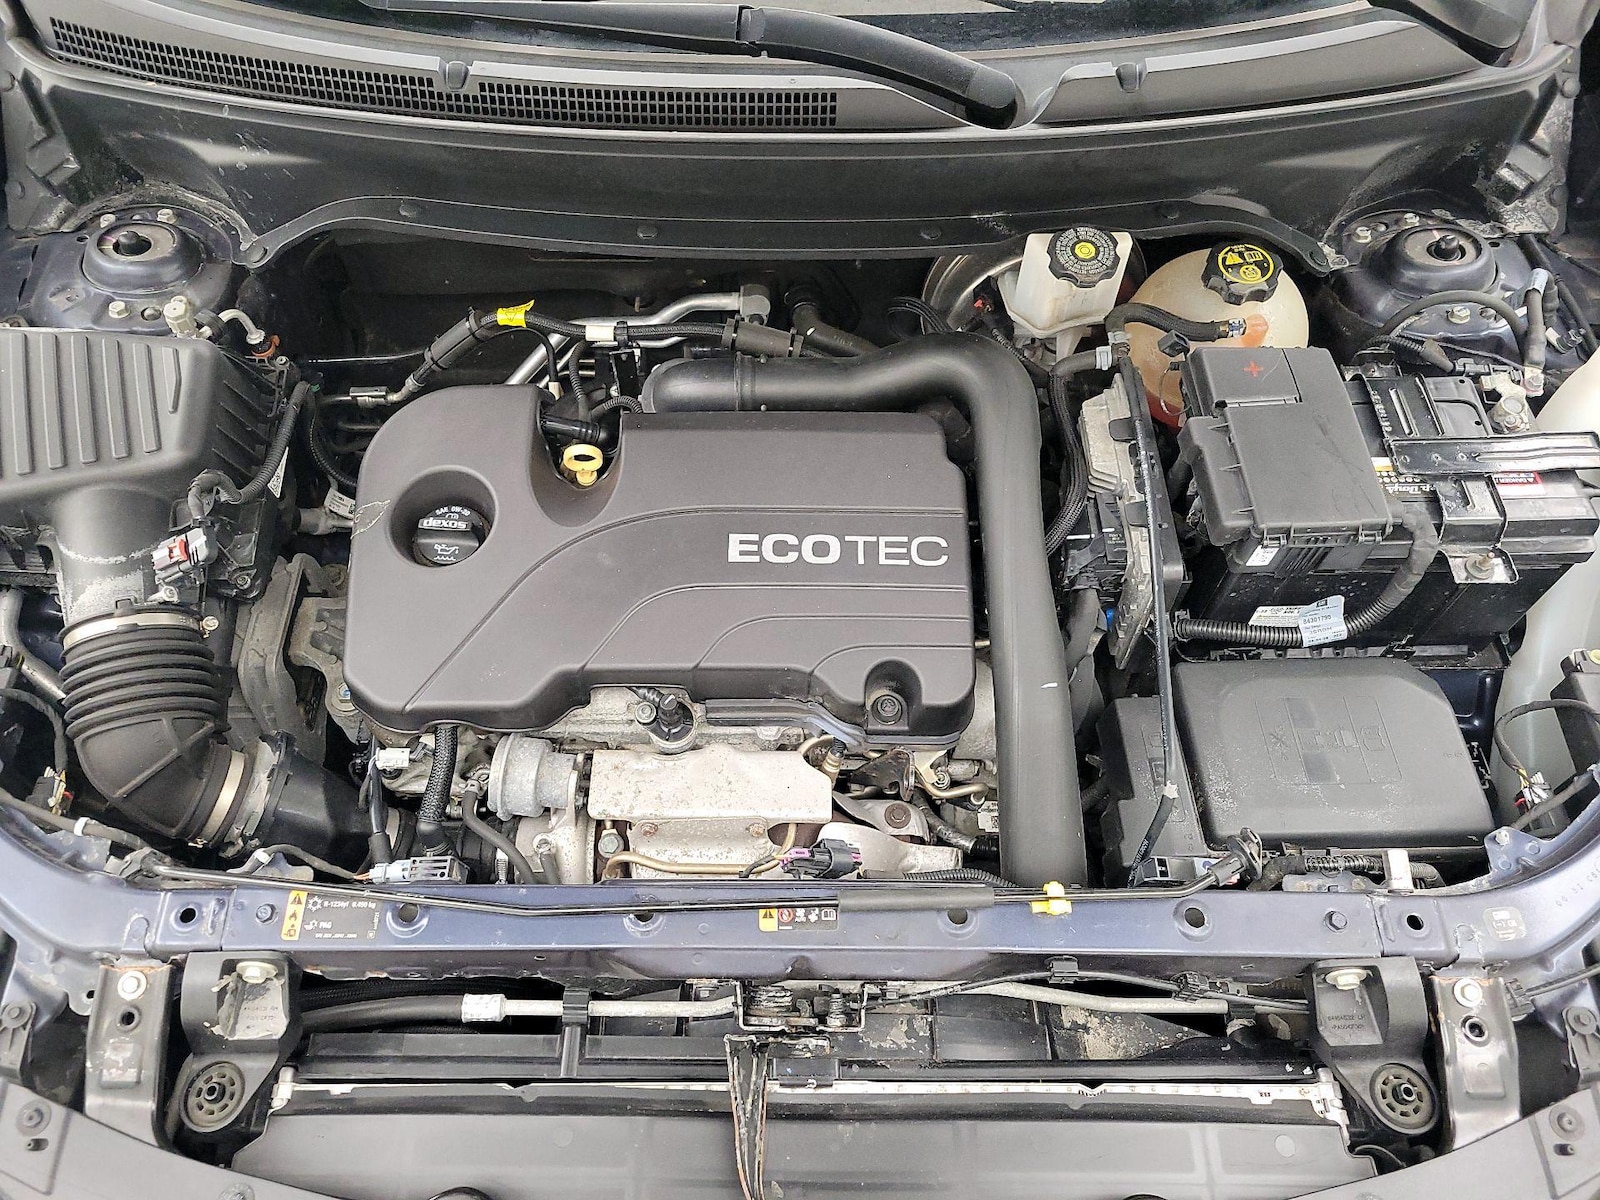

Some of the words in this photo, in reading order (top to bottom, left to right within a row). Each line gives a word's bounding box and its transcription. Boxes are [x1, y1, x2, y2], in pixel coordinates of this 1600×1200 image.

[435, 506, 449, 515] SAE
[451, 506, 471, 516] 0W-20
[422, 517, 468, 529] dexos
[728, 533, 949, 567] ECOTEC
[319, 921, 332, 929] PAG
